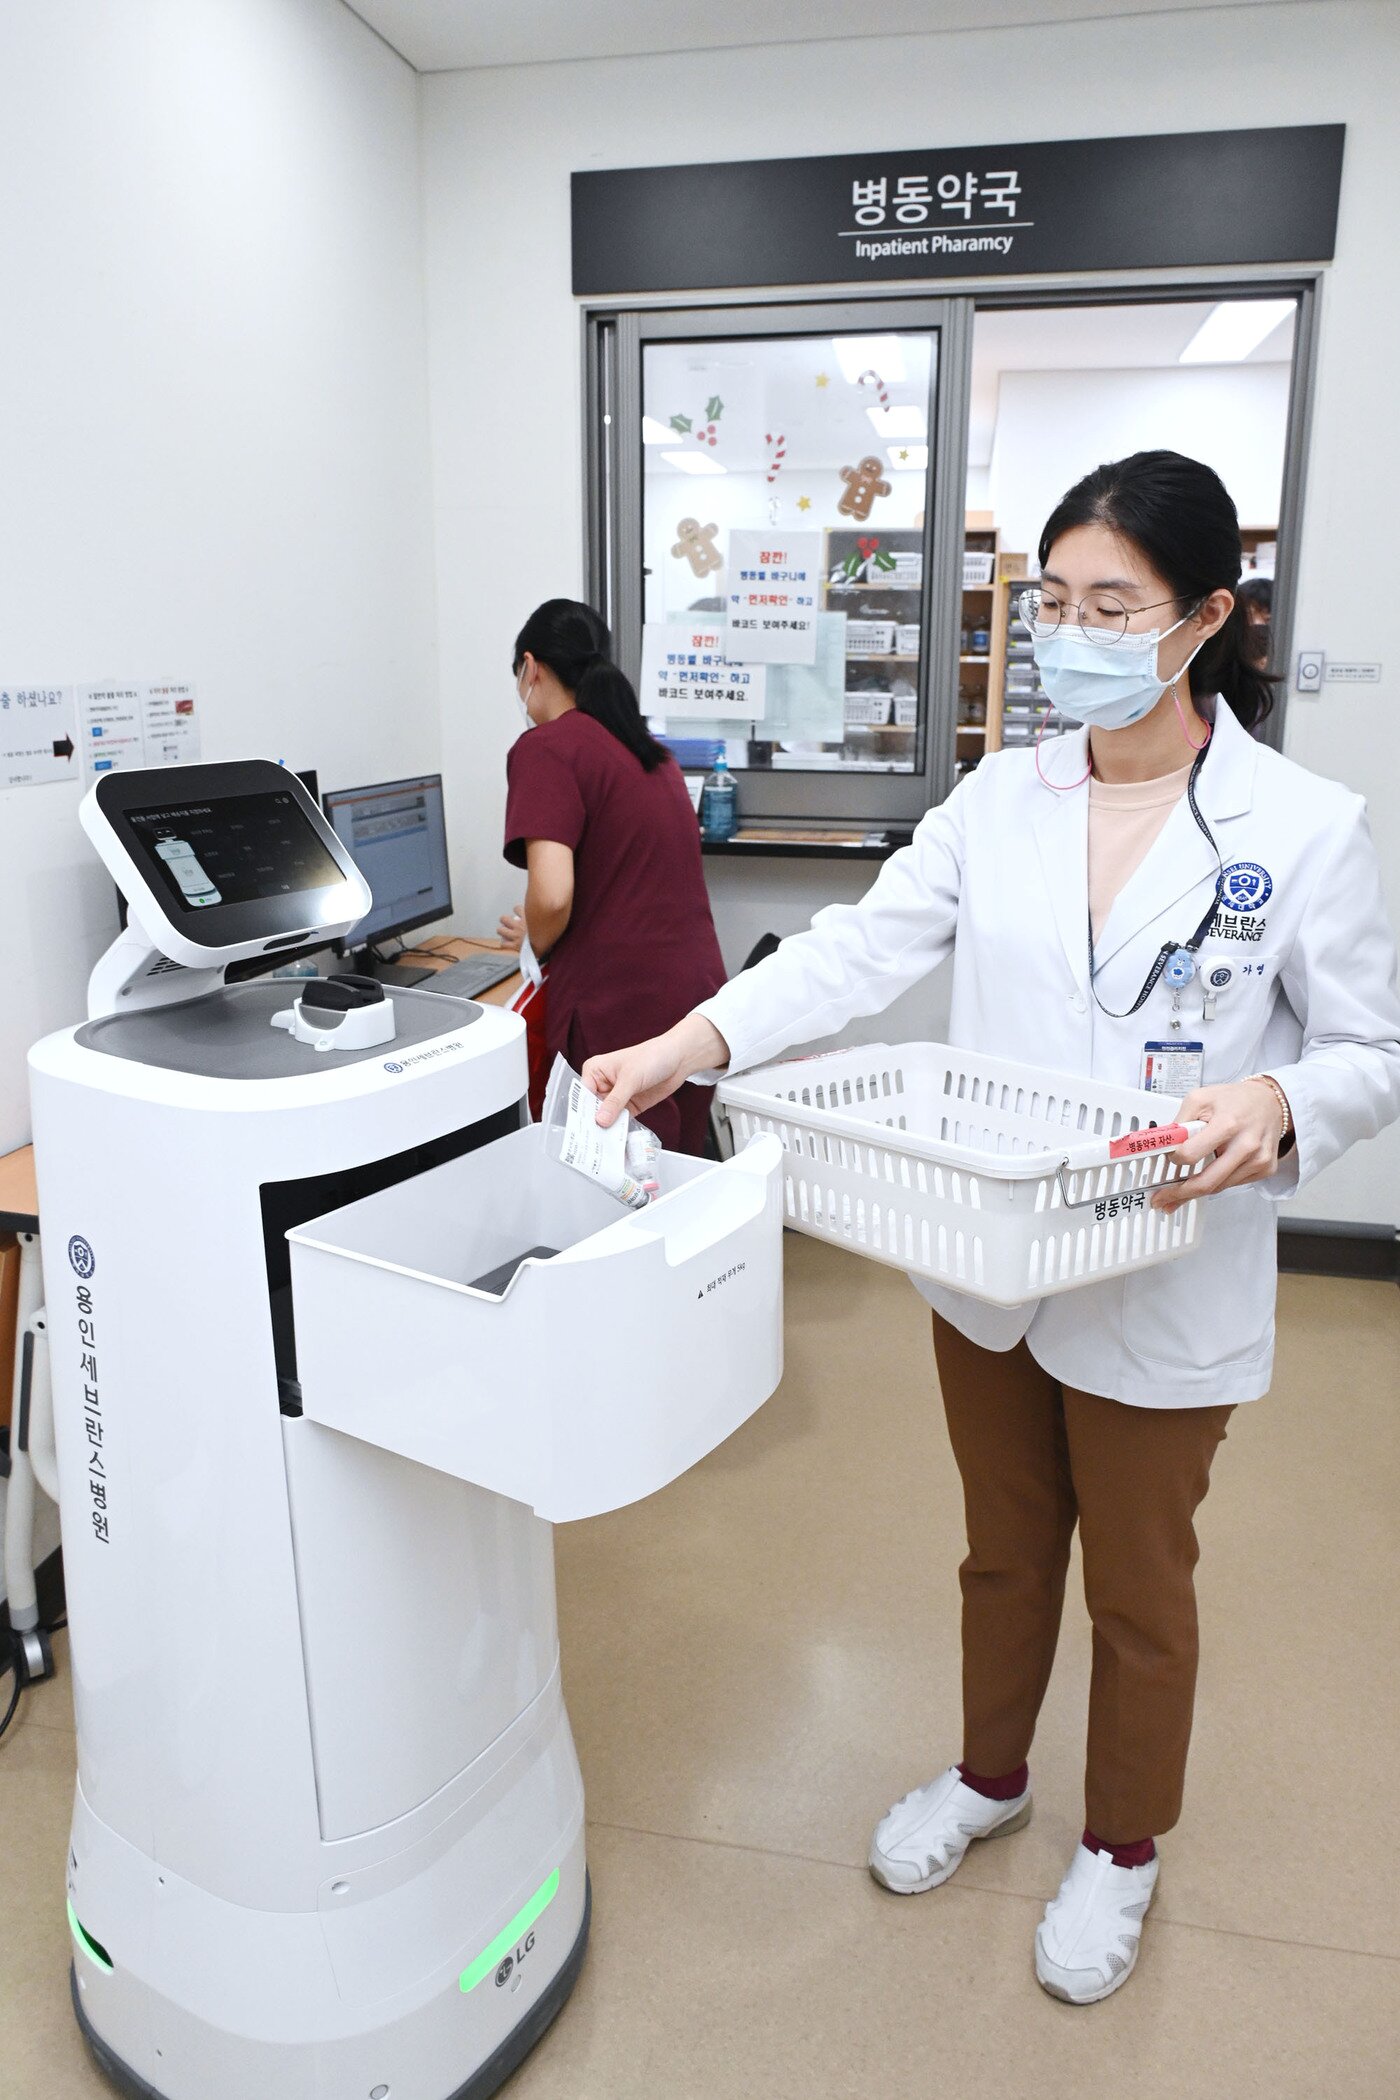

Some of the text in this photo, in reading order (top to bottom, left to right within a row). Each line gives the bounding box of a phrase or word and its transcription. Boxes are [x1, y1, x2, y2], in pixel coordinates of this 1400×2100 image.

[852, 171, 1022, 226] 병동약국
[855, 234, 1014, 261] Inpatient Pharamcy
[760, 551, 788, 564] 잠깐!
[771, 571, 807, 581] 바구니에
[731, 594, 740, 605] 약
[796, 596, 813, 607] 하고
[731, 619, 810, 631] 바코드 보여주세요!
[692, 635, 719, 648] 잠깐!
[658, 670, 668, 681] 약
[730, 672, 750, 685] 하고
[17, 690, 62, 708] 하셨나요?
[658, 687, 688, 699] 바코드
[1095, 1192, 1145, 1221] 병동약국
[76, 1285, 109, 1544] 용인세브란스병원
[516, 1931, 535, 1965] LG
